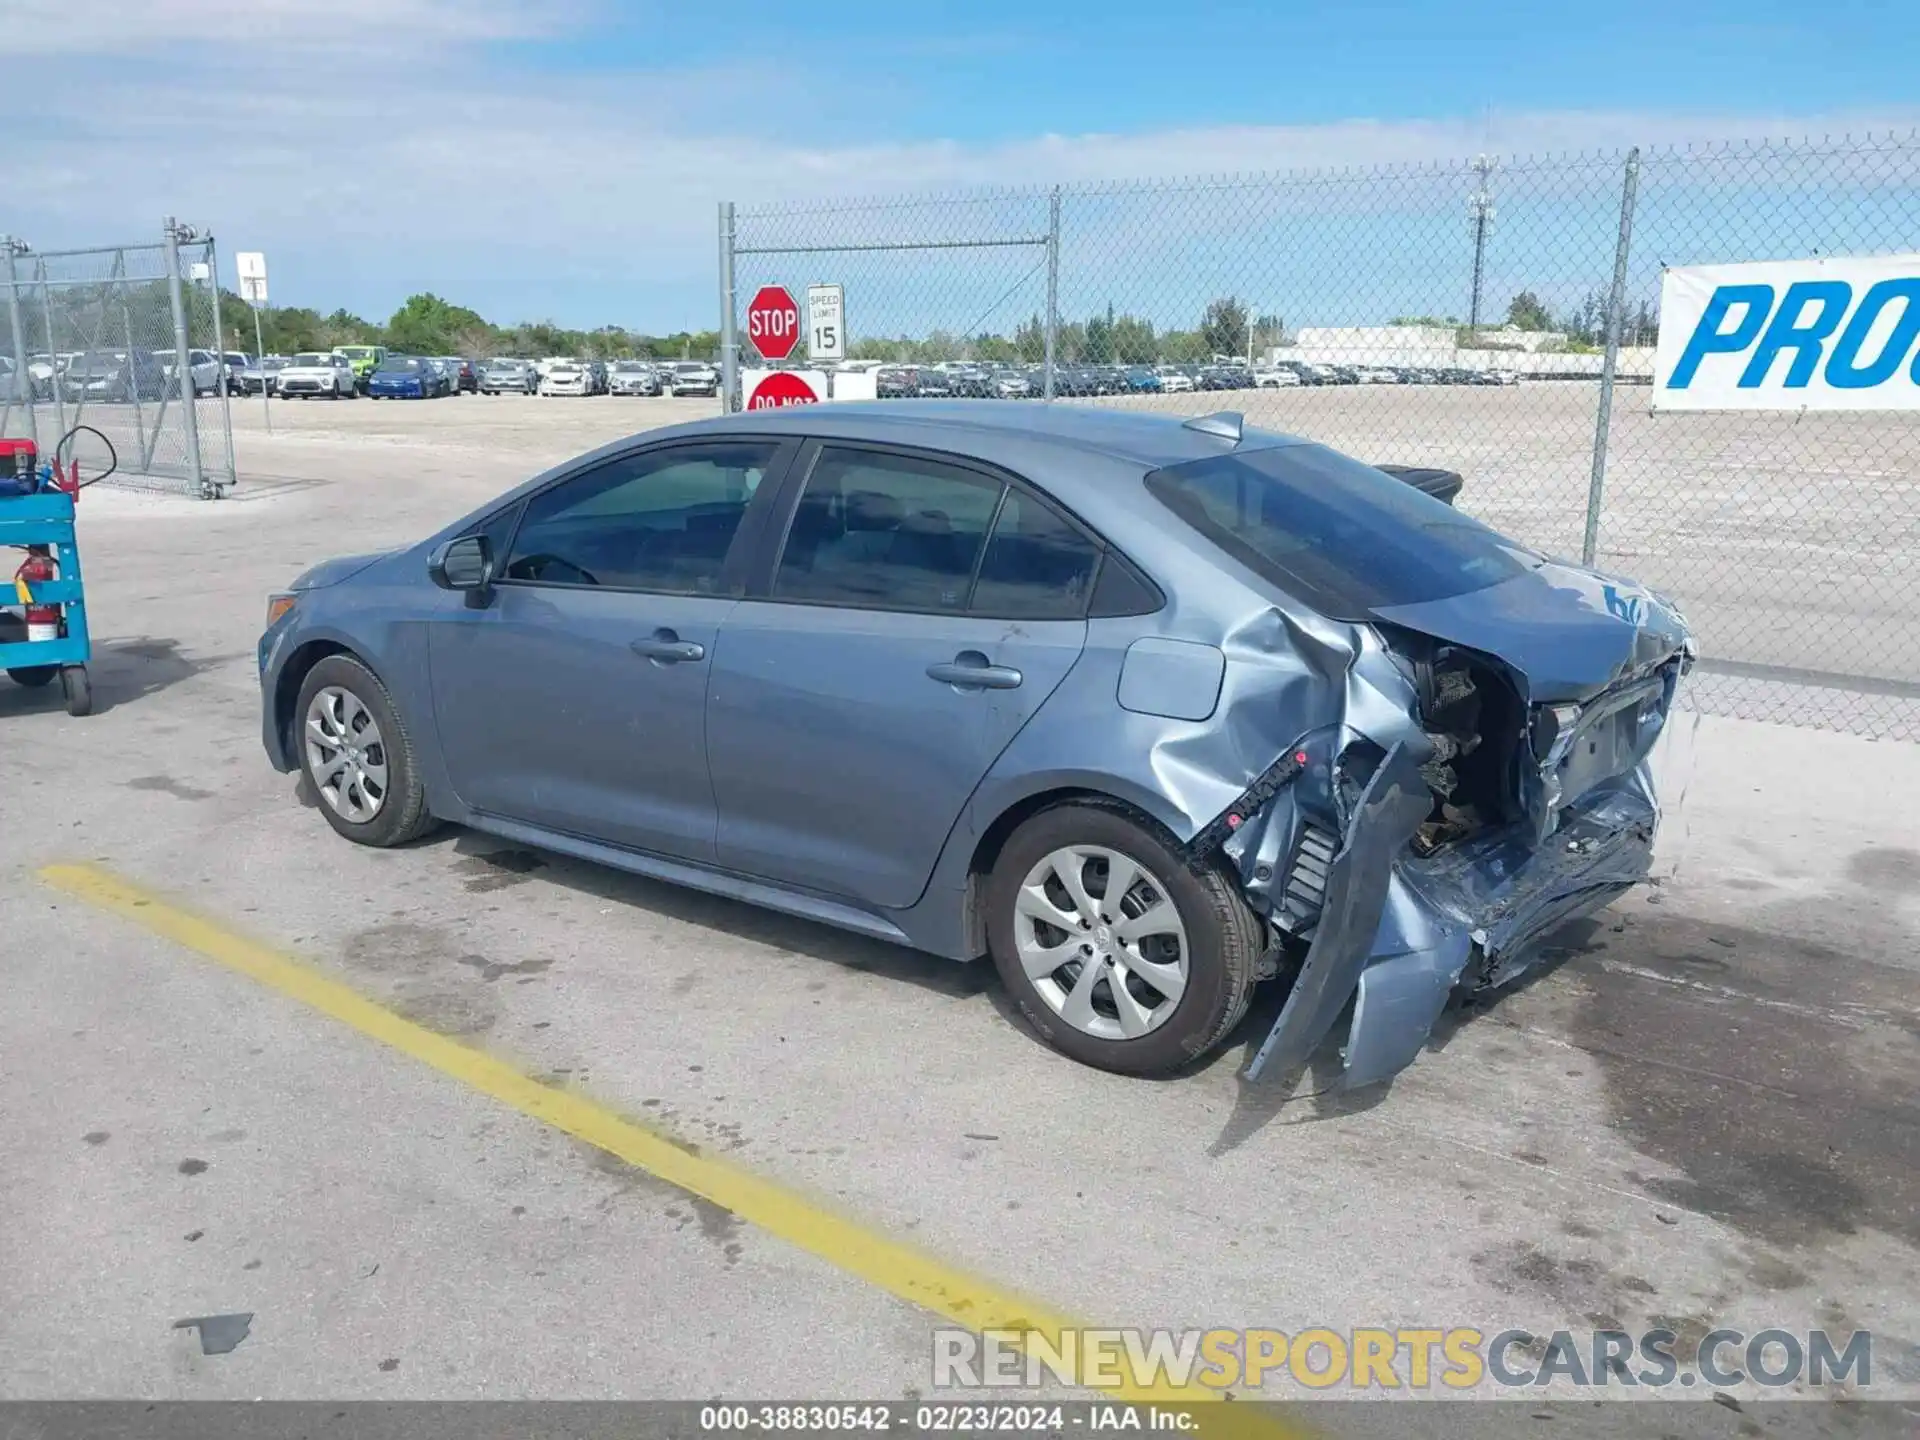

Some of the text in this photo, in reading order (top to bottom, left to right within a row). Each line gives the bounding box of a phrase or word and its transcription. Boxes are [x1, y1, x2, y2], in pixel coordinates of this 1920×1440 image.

[810, 295, 839, 306] SPEED
[750, 309, 796, 337] STOP
[813, 308, 837, 320] LIMIT
[815, 326, 836, 349] 15
[1665, 277, 1920, 389] PRO
[756, 395, 776, 410] DO
